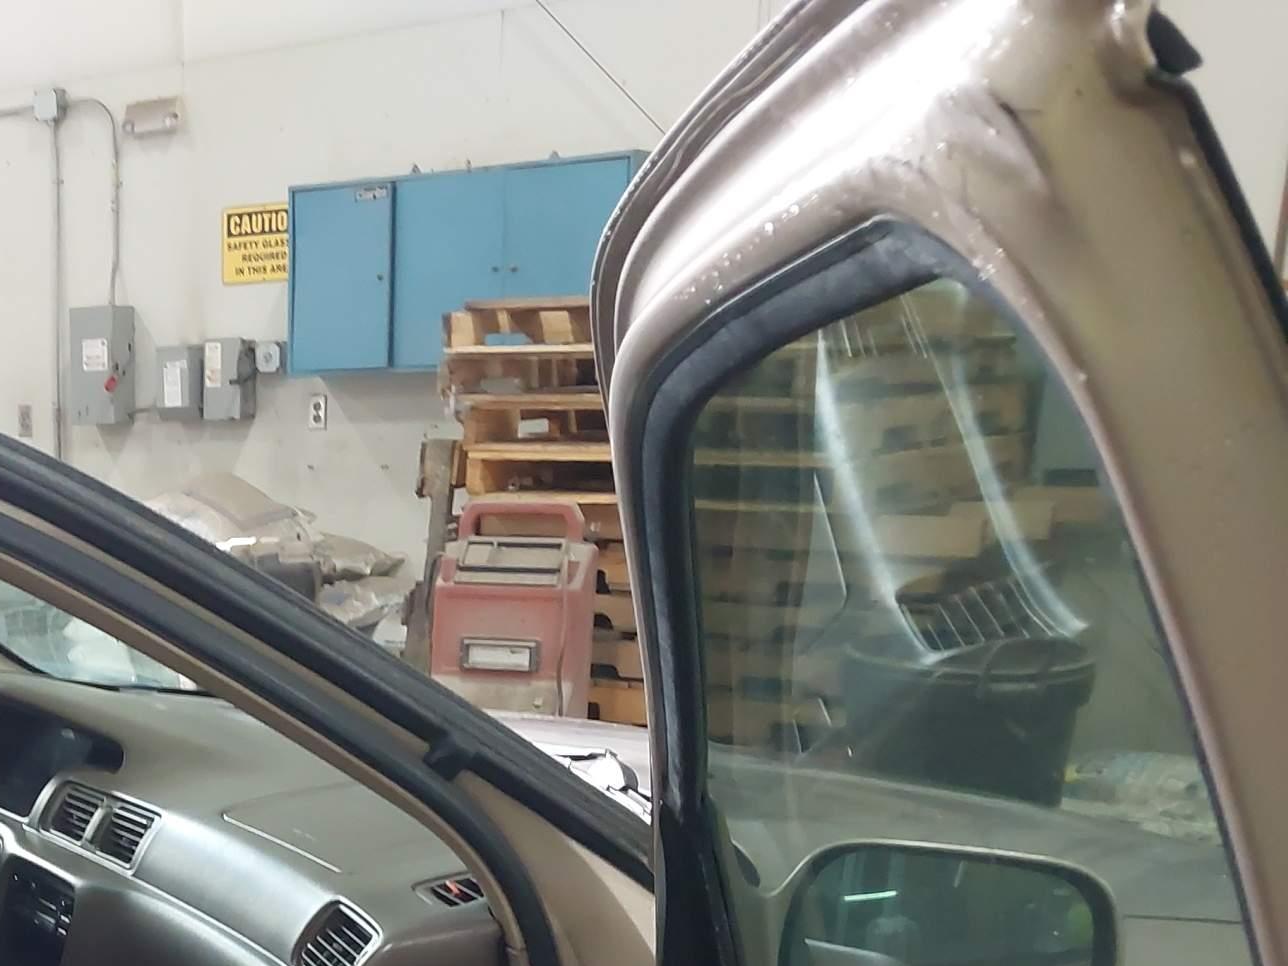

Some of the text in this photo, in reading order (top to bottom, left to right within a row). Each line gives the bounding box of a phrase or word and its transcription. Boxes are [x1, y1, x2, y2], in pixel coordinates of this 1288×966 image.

[229, 211, 288, 235] CAUTIO
[262, 238, 289, 249] GLAS
[270, 263, 288, 273] ARE
